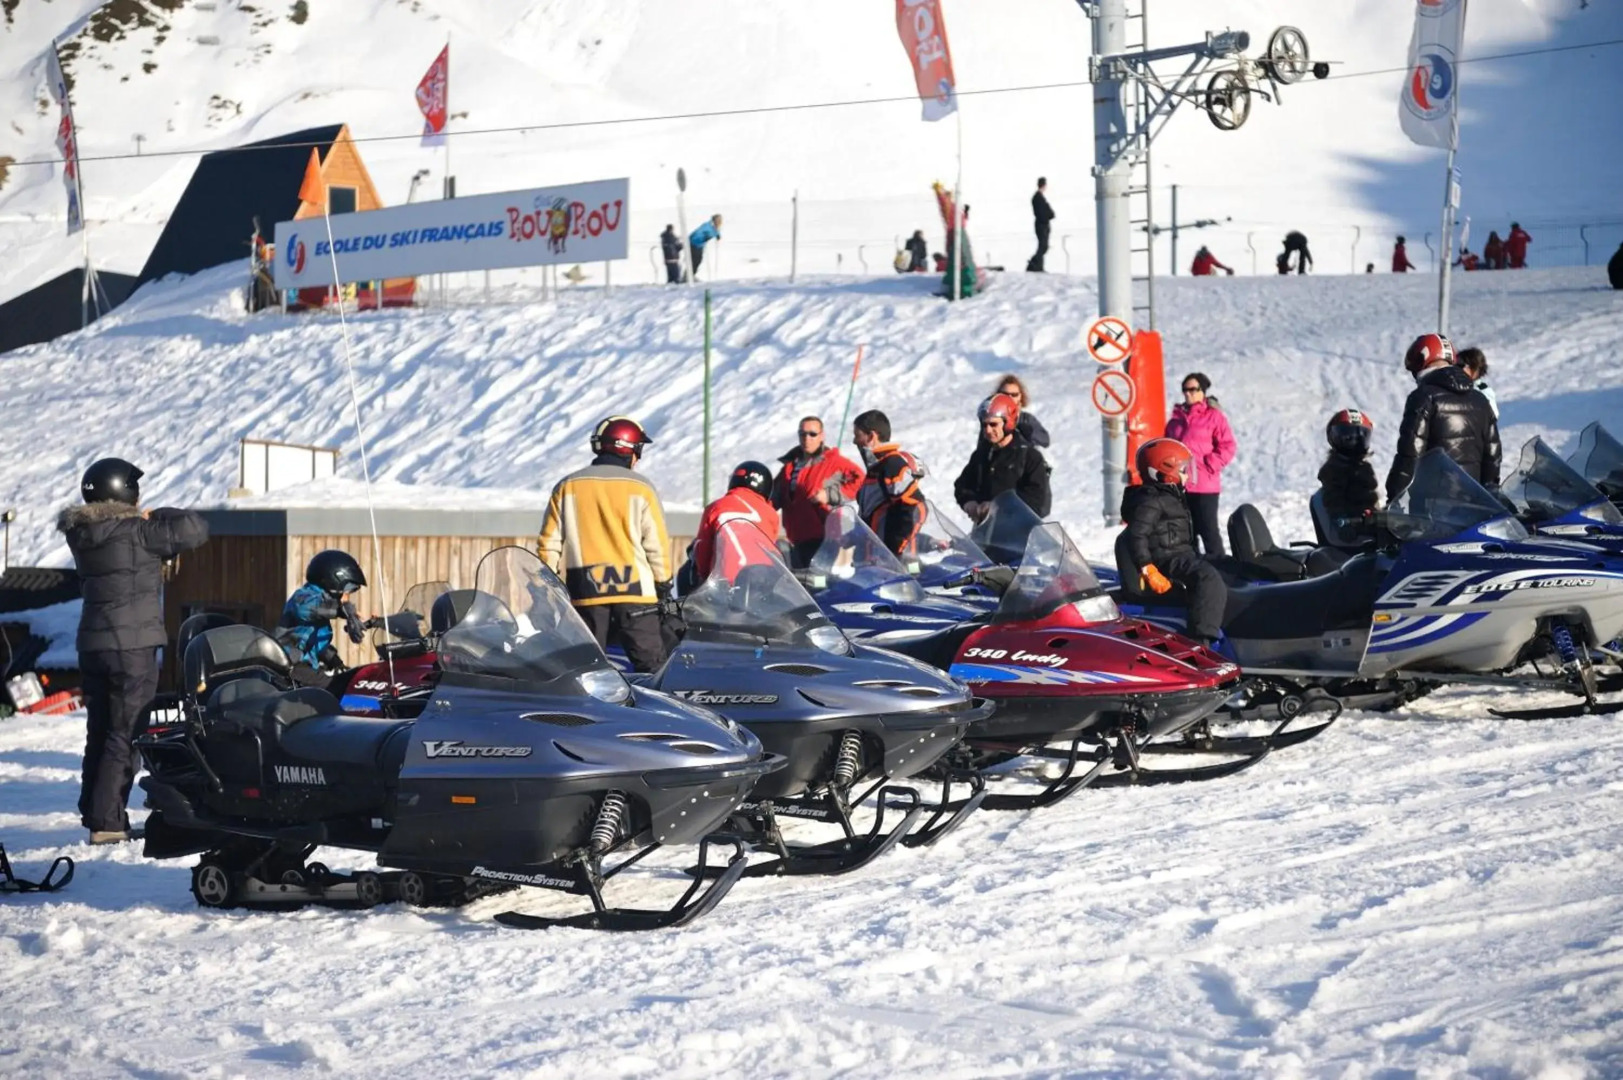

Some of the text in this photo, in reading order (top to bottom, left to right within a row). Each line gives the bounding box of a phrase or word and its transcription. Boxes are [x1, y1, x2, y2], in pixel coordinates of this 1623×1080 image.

[315, 237, 361, 256] ECOLE
[361, 234, 386, 250] DU
[389, 229, 417, 249] SKI
[419, 220, 505, 244] FRANÇAIS
[1463, 579, 1596, 595] EDGE TOURING
[964, 647, 1008, 659] 340
[274, 765, 327, 785] YAMAHA
[470, 865, 534, 883] PROACTION
